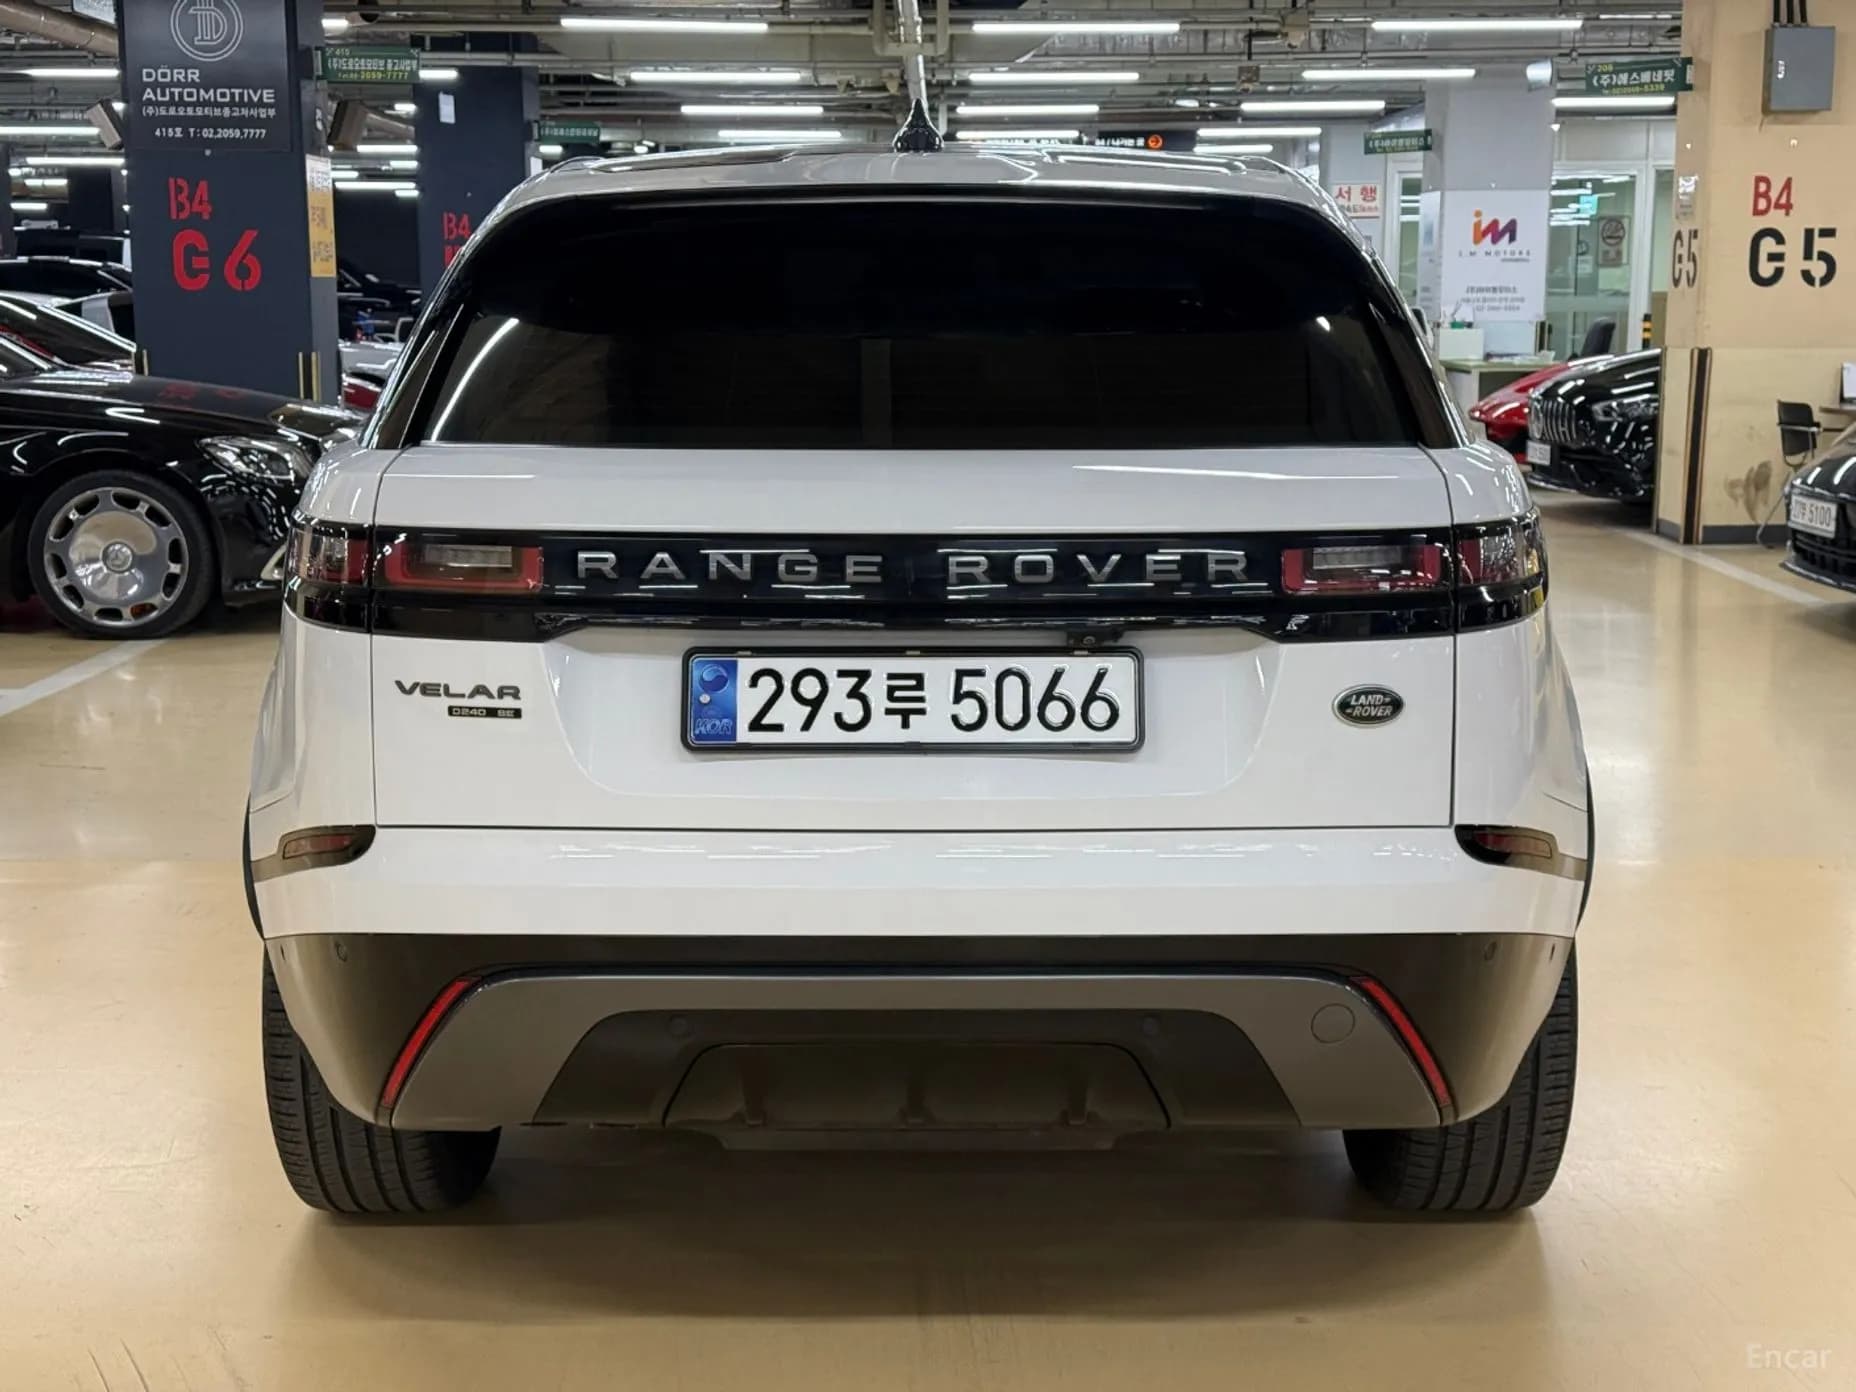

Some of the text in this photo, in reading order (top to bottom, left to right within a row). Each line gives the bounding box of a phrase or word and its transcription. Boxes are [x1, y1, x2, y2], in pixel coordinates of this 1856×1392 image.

[142, 65, 201, 82] DÖRR
[142, 87, 275, 103] AUTOMOTIVE
[168, 177, 213, 220] B4
[1752, 175, 1794, 217] B4
[443, 211, 471, 240] B4
[577, 551, 1247, 584] RANGE ROVER
[394, 680, 522, 700] VELAR
[950, 667, 1120, 733] 5066
[452, 707, 516, 717] D240 SE
